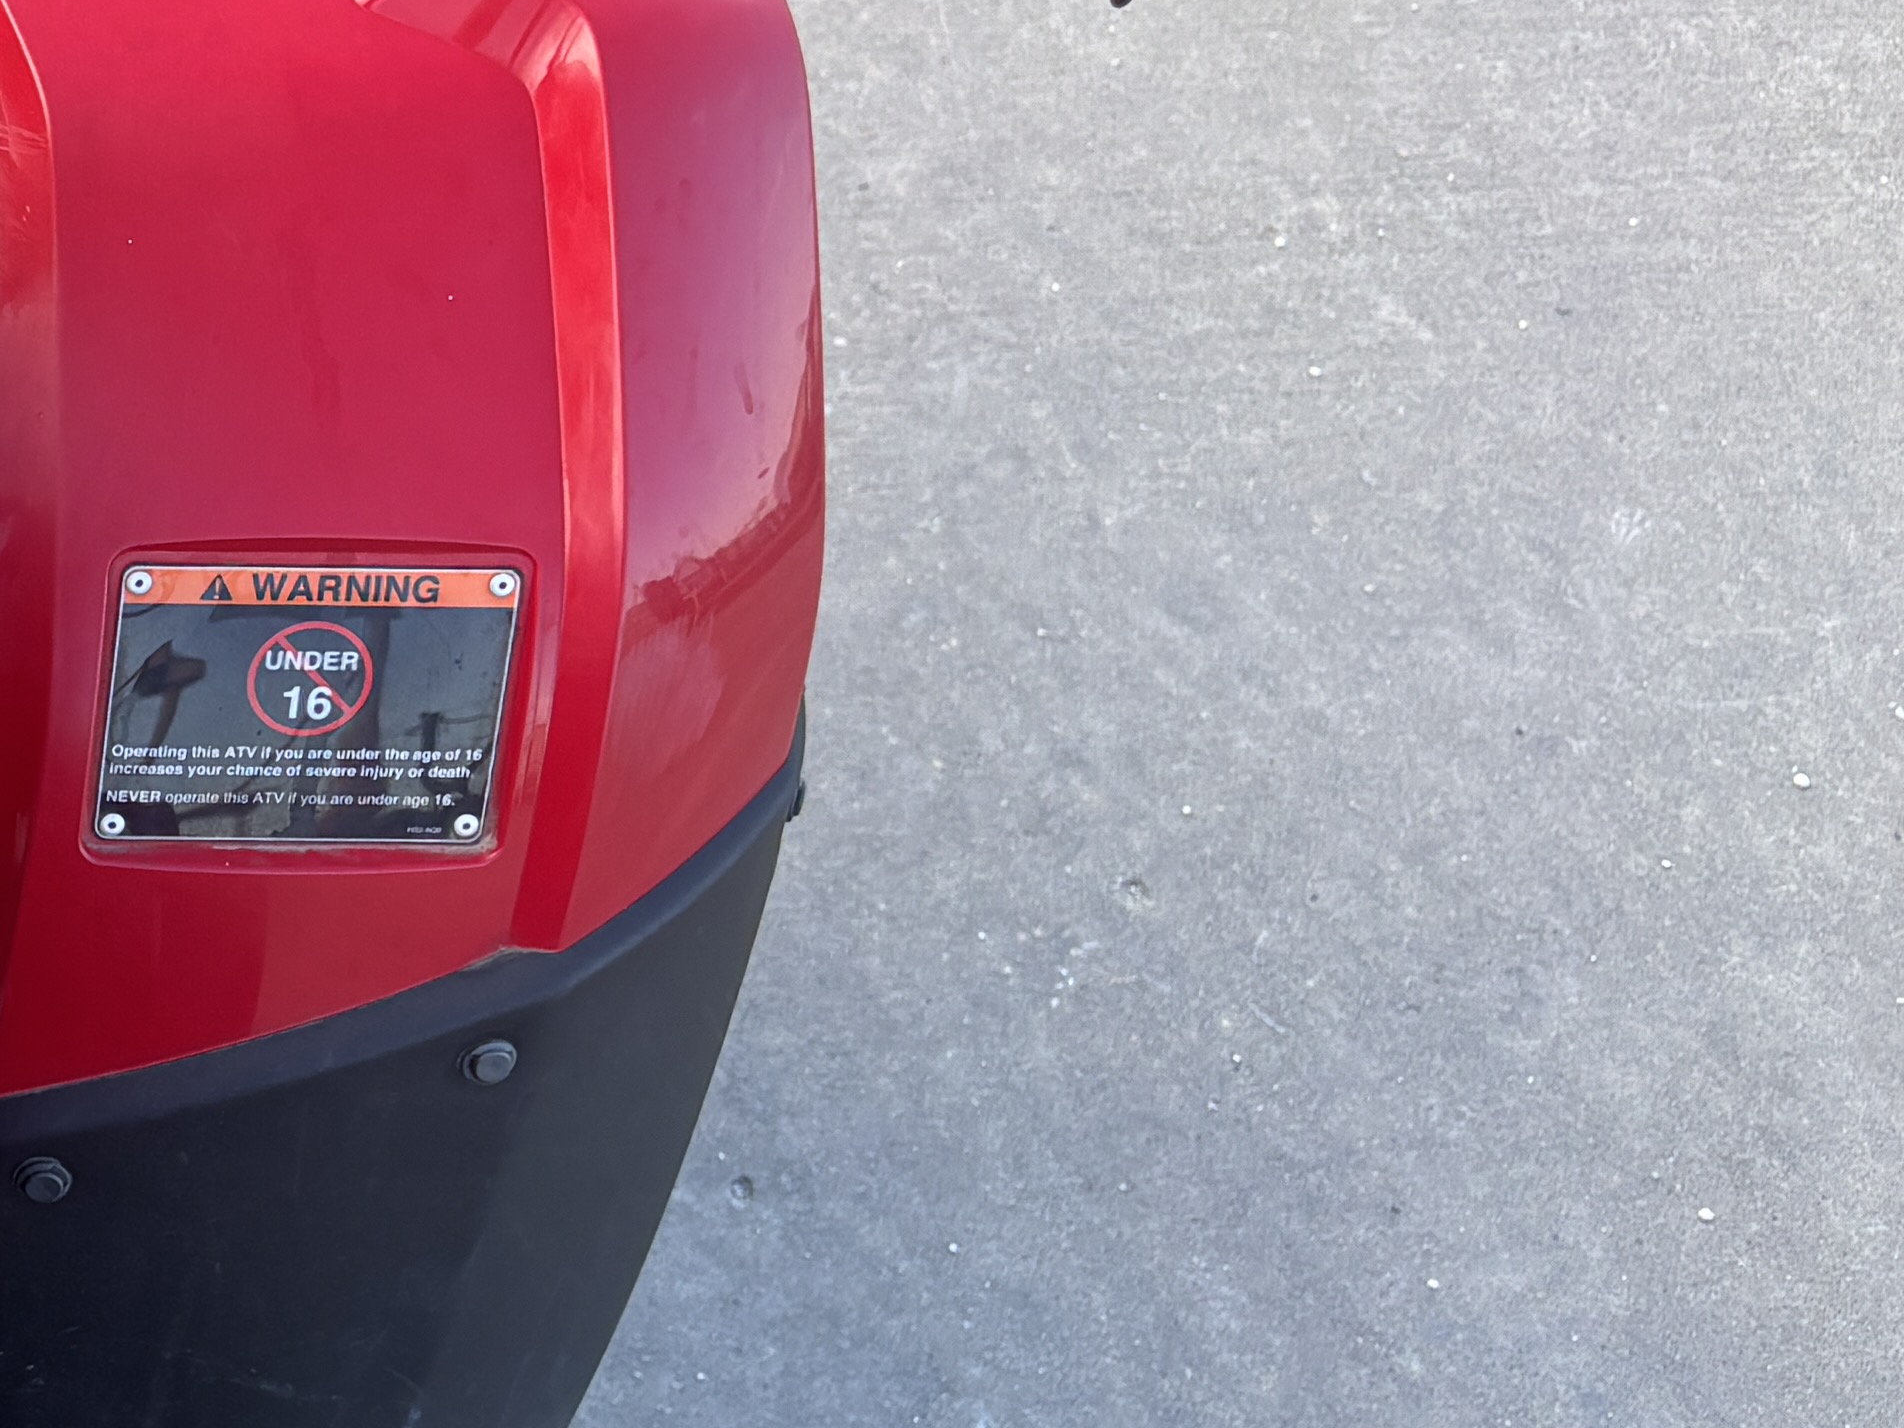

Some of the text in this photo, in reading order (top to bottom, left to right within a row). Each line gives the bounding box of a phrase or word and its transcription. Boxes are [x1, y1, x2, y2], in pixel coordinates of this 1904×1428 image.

[252, 573, 440, 606] WARNING
[264, 649, 360, 672] UNDER
[282, 686, 334, 720] 16
[111, 744, 483, 764] Operating this ATV if you are under the age of 16
[109, 763, 474, 781] increases your chance of severe injury or death.
[106, 789, 455, 809] NEVER operate this ATV if you are under age 16.
